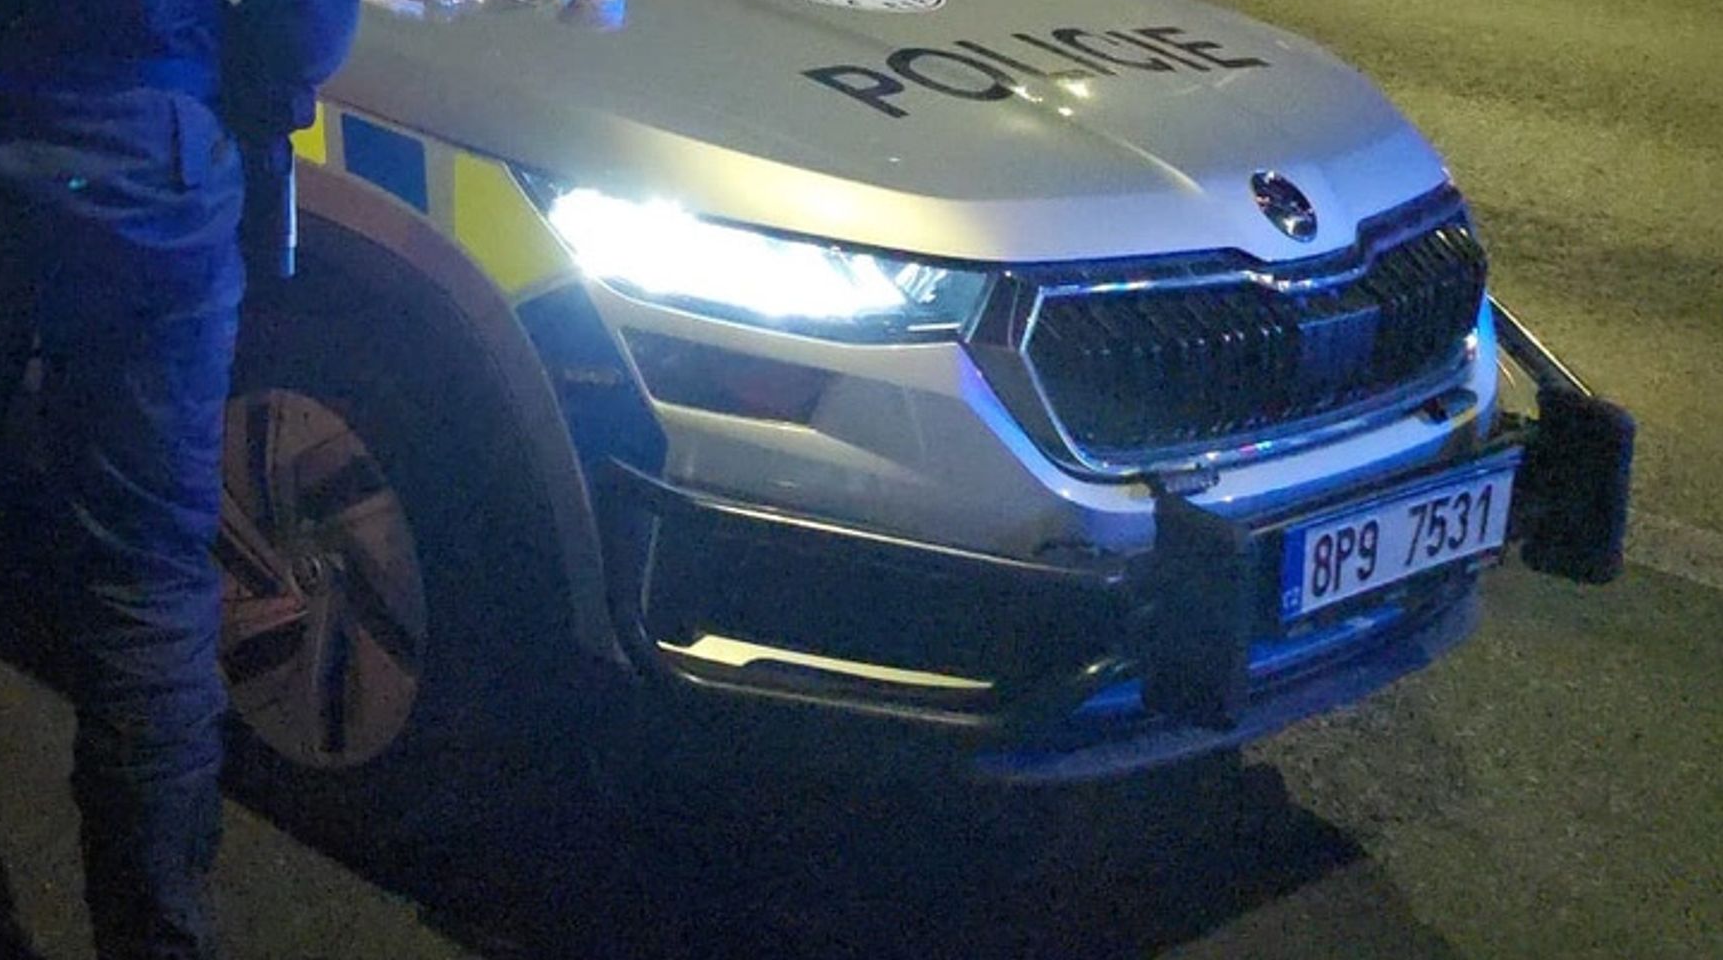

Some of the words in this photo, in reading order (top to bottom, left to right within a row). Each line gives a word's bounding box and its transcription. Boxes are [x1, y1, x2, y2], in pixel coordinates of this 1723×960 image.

[800, 26, 1272, 120] POLICIE
[1310, 519, 1380, 598] 8P9
[1402, 483, 1493, 567] 7531
